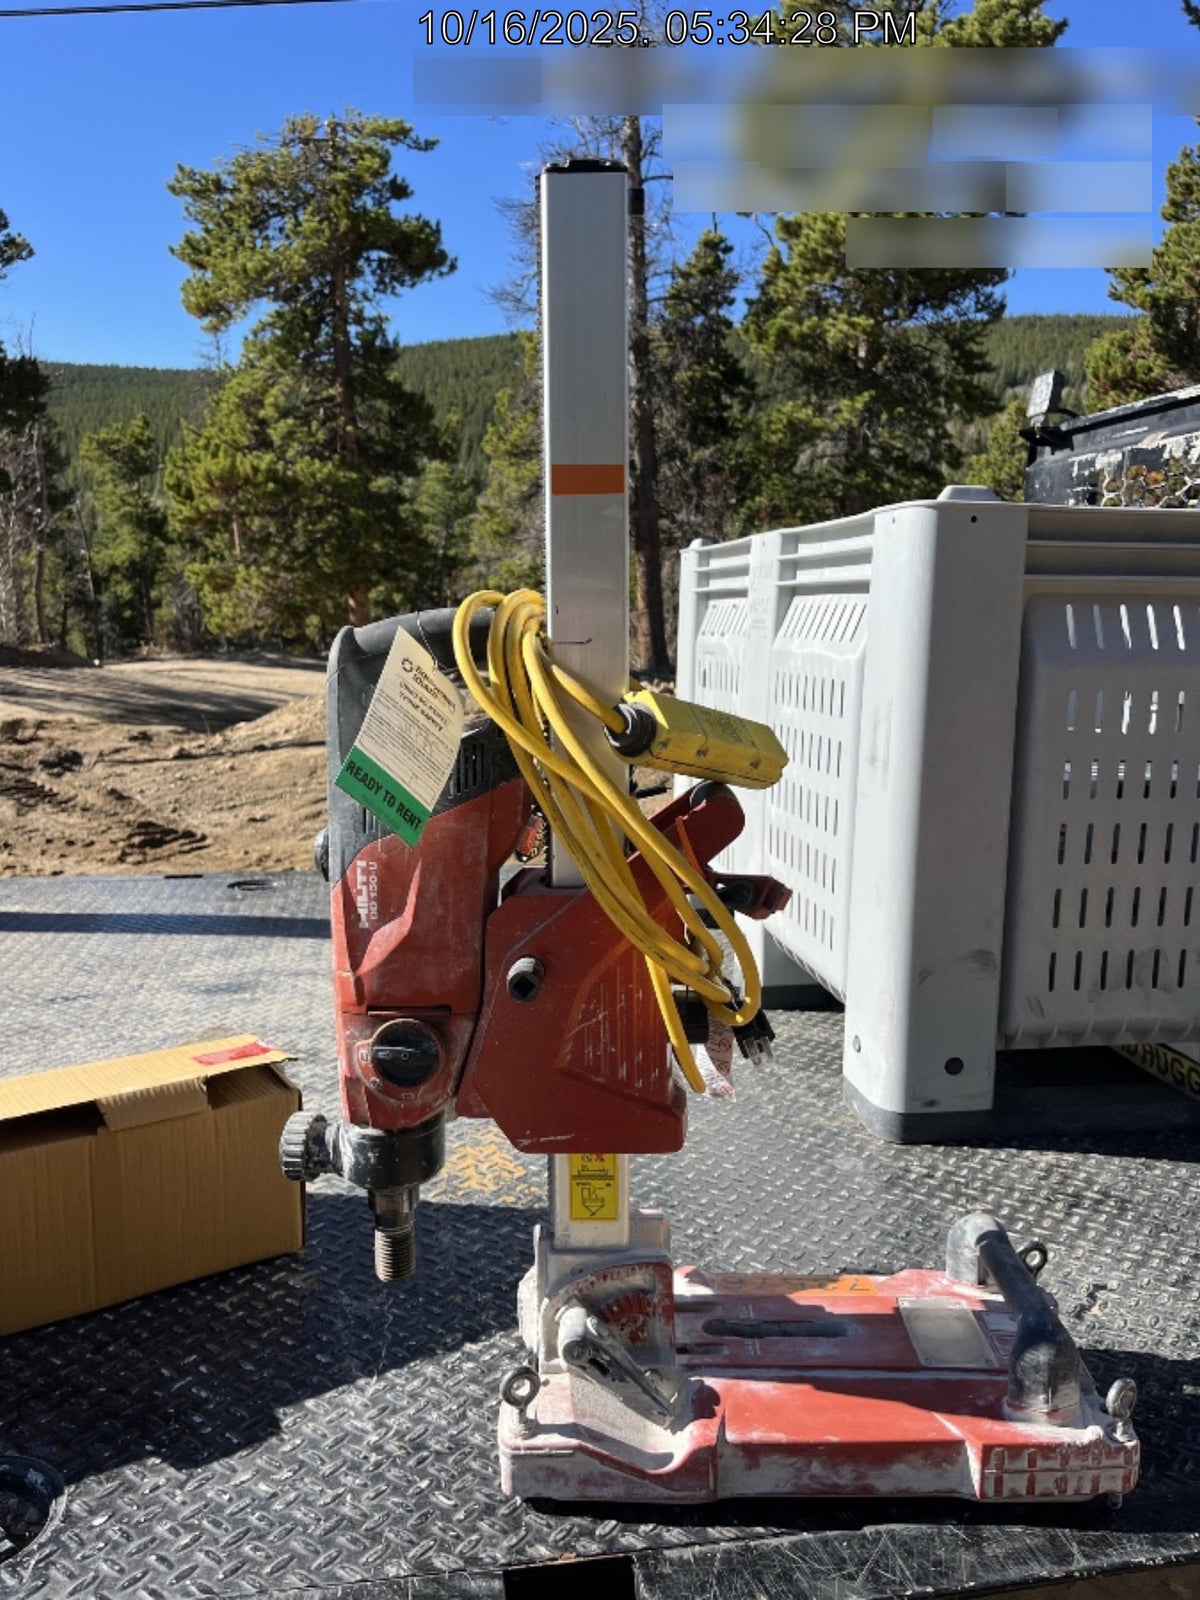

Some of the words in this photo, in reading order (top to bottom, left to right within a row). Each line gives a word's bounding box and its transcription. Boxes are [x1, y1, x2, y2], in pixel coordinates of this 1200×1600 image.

[346, 760, 383, 796] READY
[383, 789, 397, 808] TO
[396, 800, 422, 832] RENT
[356, 860, 369, 929] HILTI
[369, 902, 378, 920] DD
